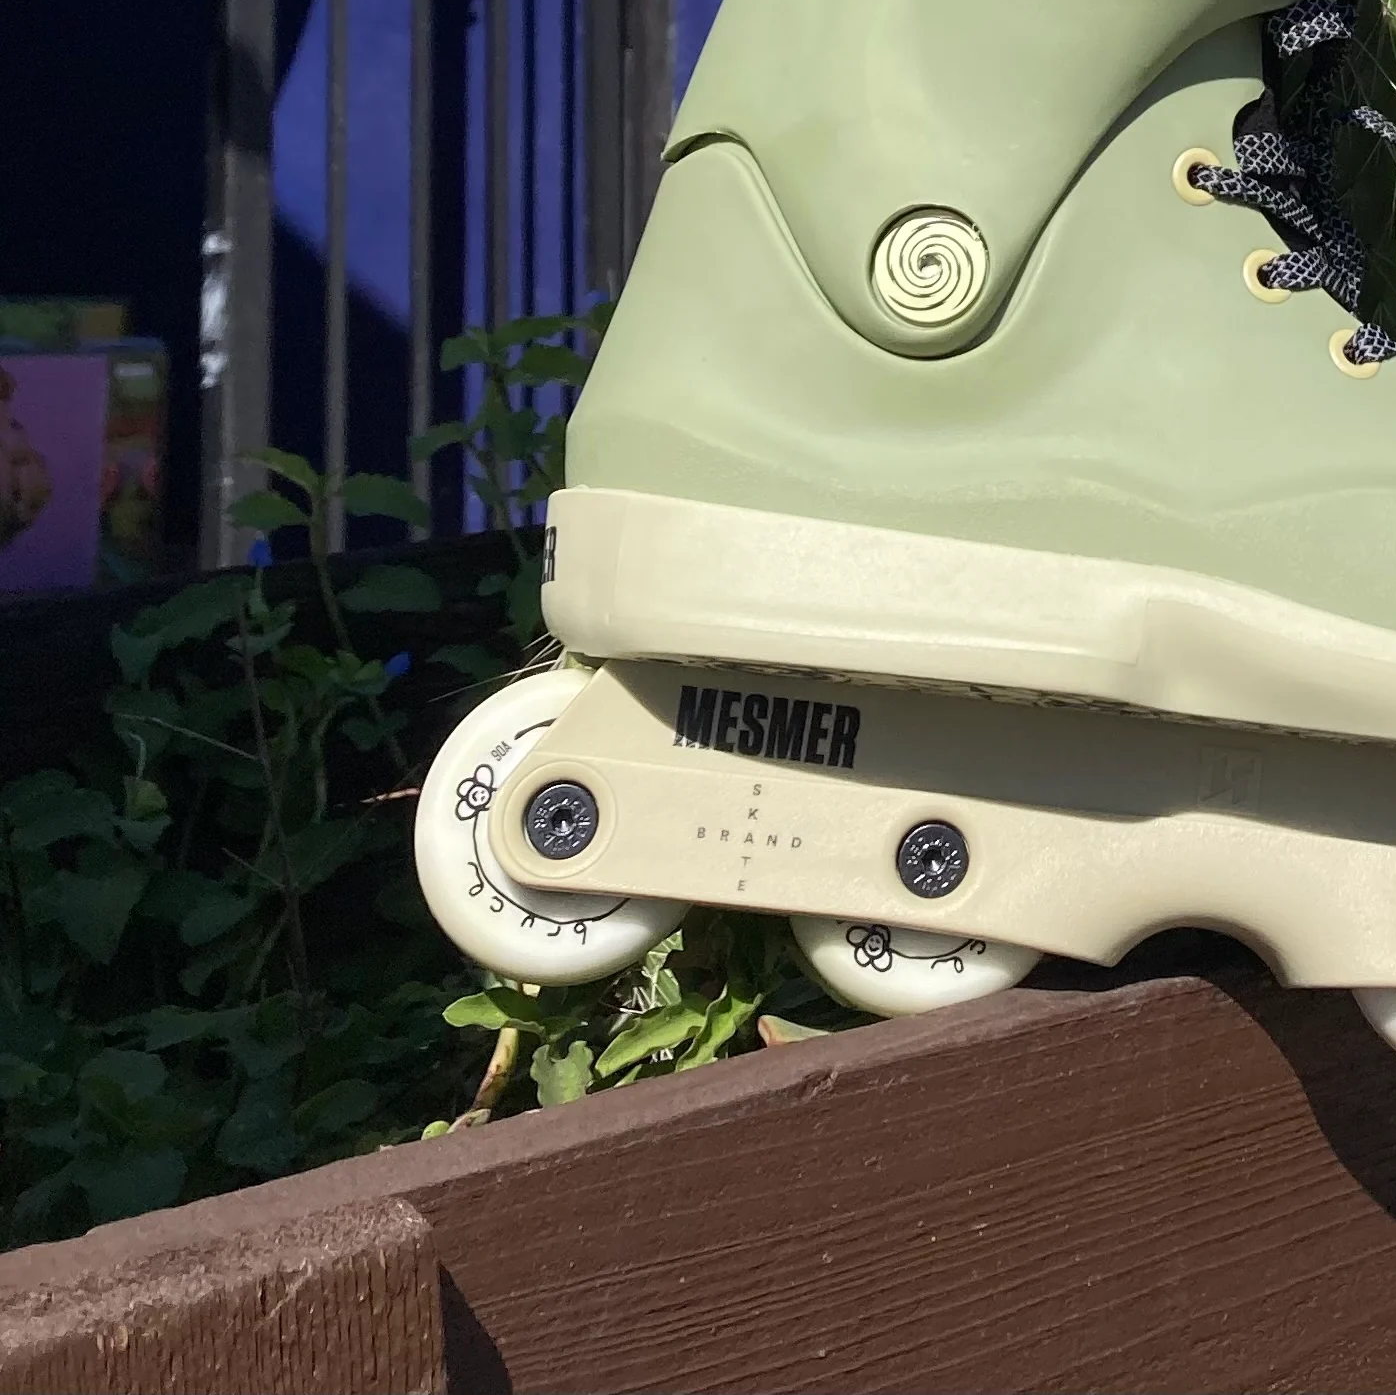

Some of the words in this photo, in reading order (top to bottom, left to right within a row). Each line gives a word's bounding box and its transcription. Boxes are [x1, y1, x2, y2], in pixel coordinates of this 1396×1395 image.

[673, 685, 861, 769] MESMER
[490, 740, 513, 762] 90A
[696, 827, 803, 849] BRAND
